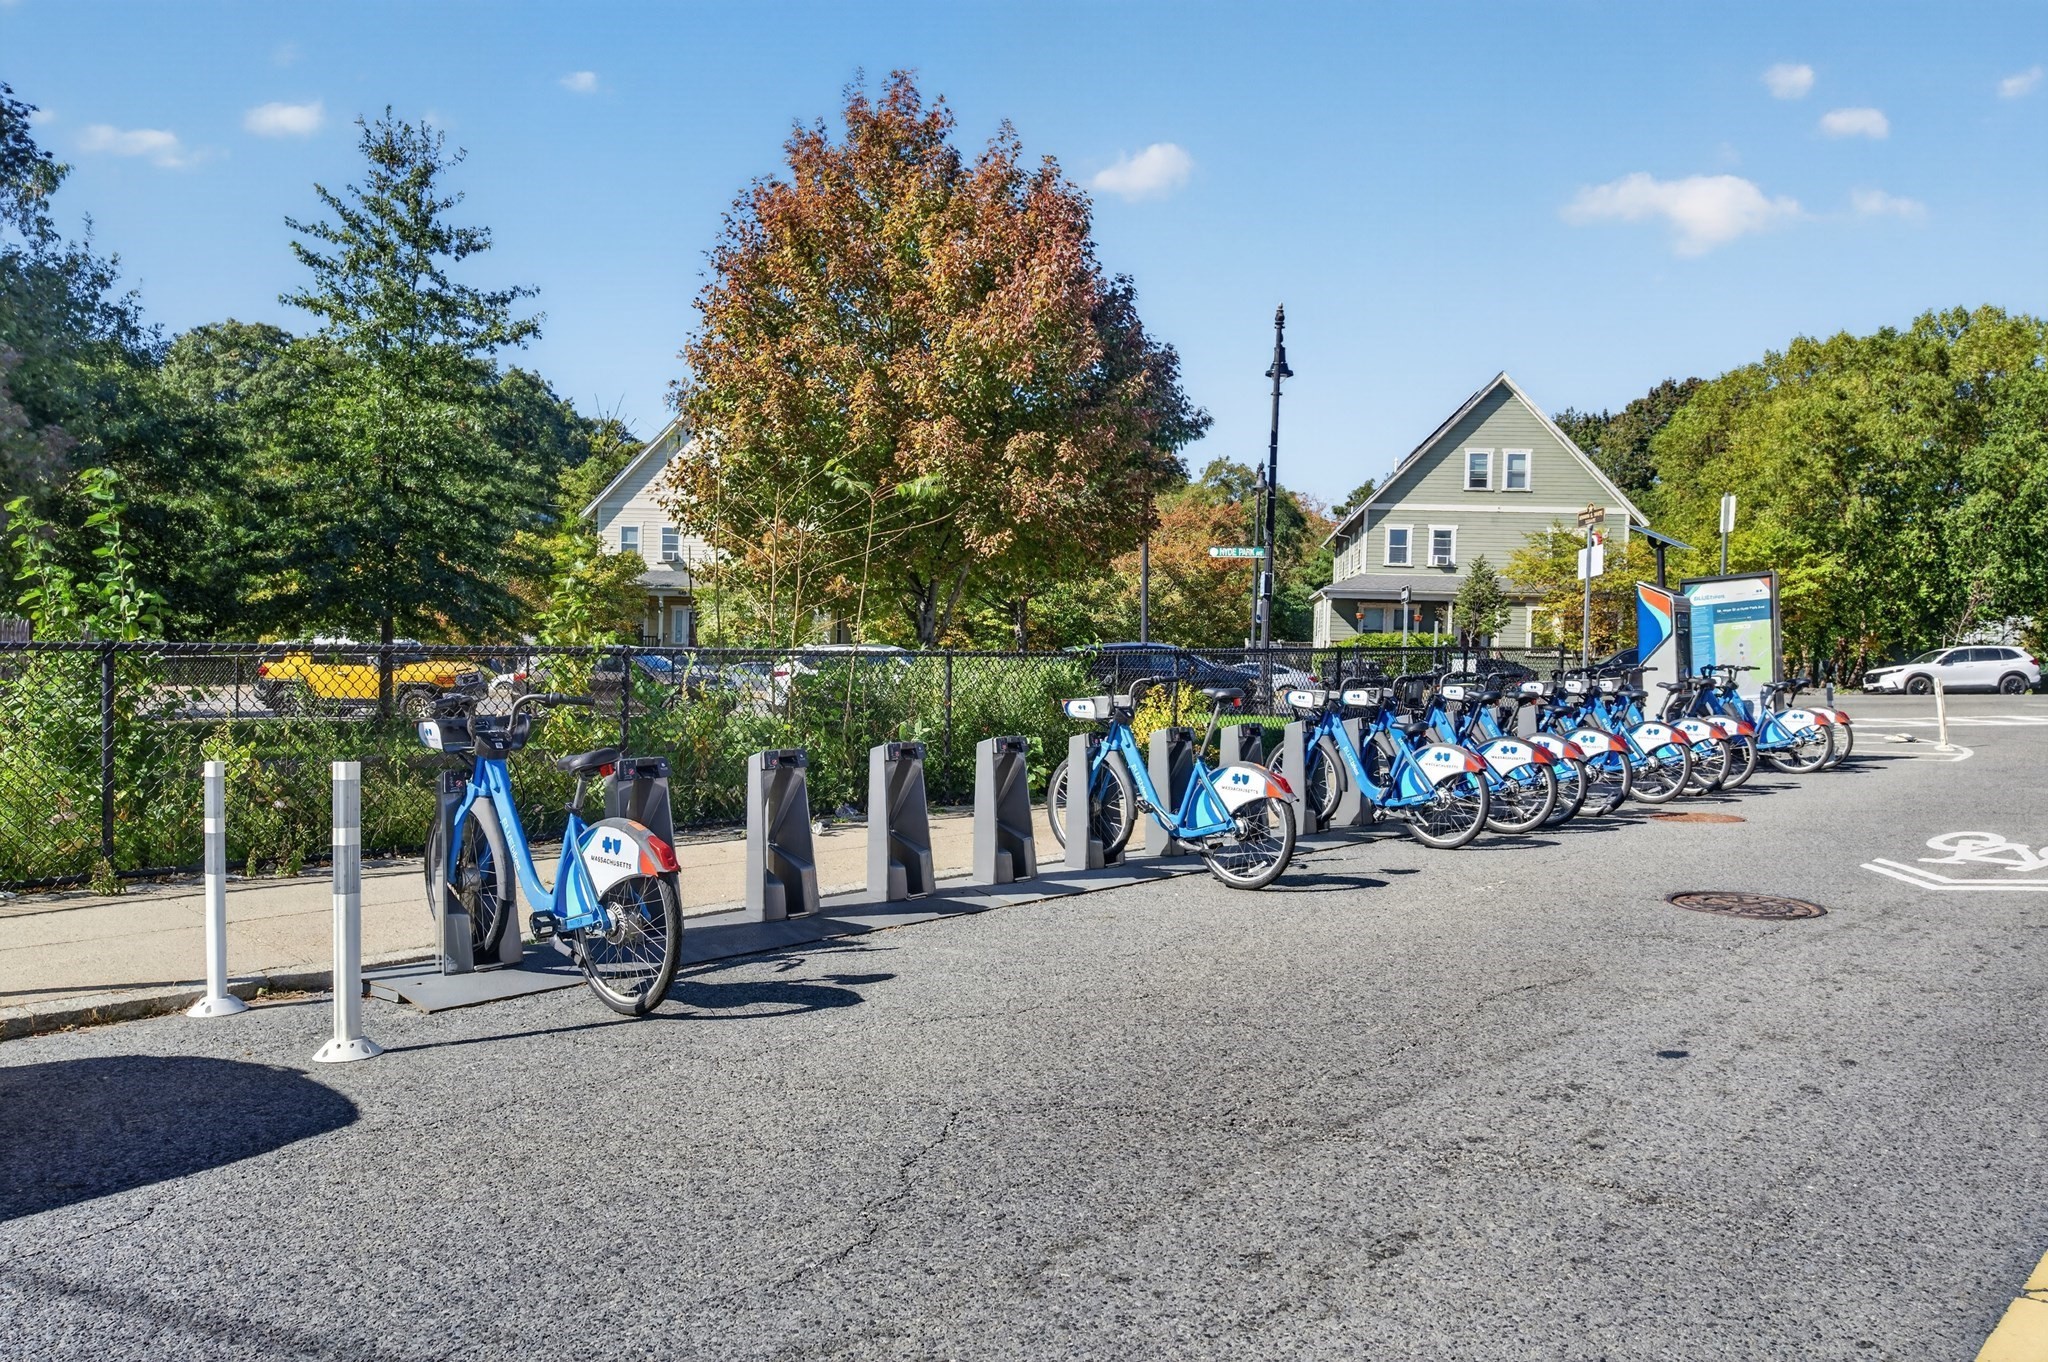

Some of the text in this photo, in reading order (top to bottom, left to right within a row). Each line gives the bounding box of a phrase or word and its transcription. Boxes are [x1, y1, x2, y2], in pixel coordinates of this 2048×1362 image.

[1220, 547, 1237, 556] HYDE
[1239, 547, 1255, 556] PARK
[1221, 785, 1259, 795] MASSACHUSETTS
[591, 855, 632, 870] MASSACHUSETTS
